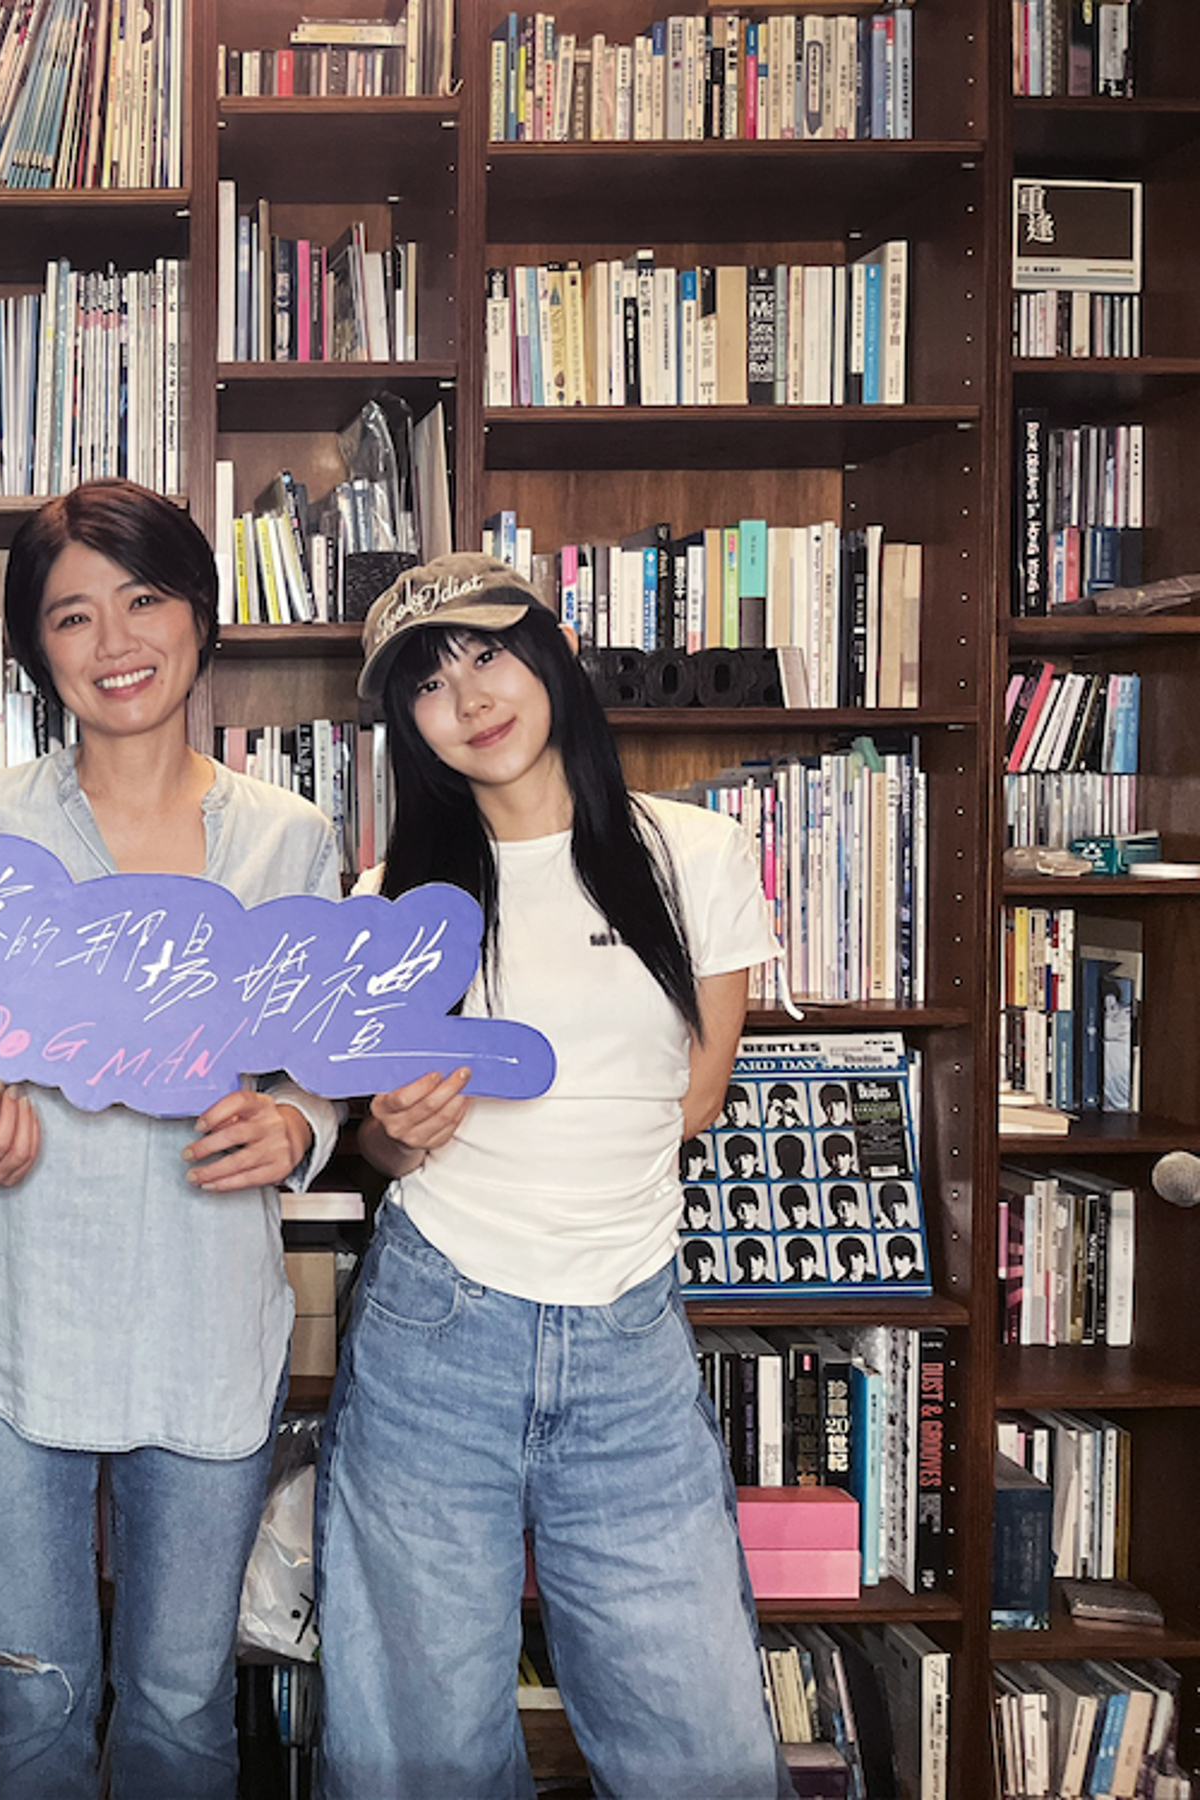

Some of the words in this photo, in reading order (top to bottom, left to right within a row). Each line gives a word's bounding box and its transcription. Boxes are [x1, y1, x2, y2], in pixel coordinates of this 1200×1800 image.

[88, 1016, 247, 1088] MAN
[731, 1059, 776, 1071] ARD
[921, 1362, 944, 1402] DUST
[920, 1404, 943, 1417] &
[919, 1420, 943, 1487] GROOVES
